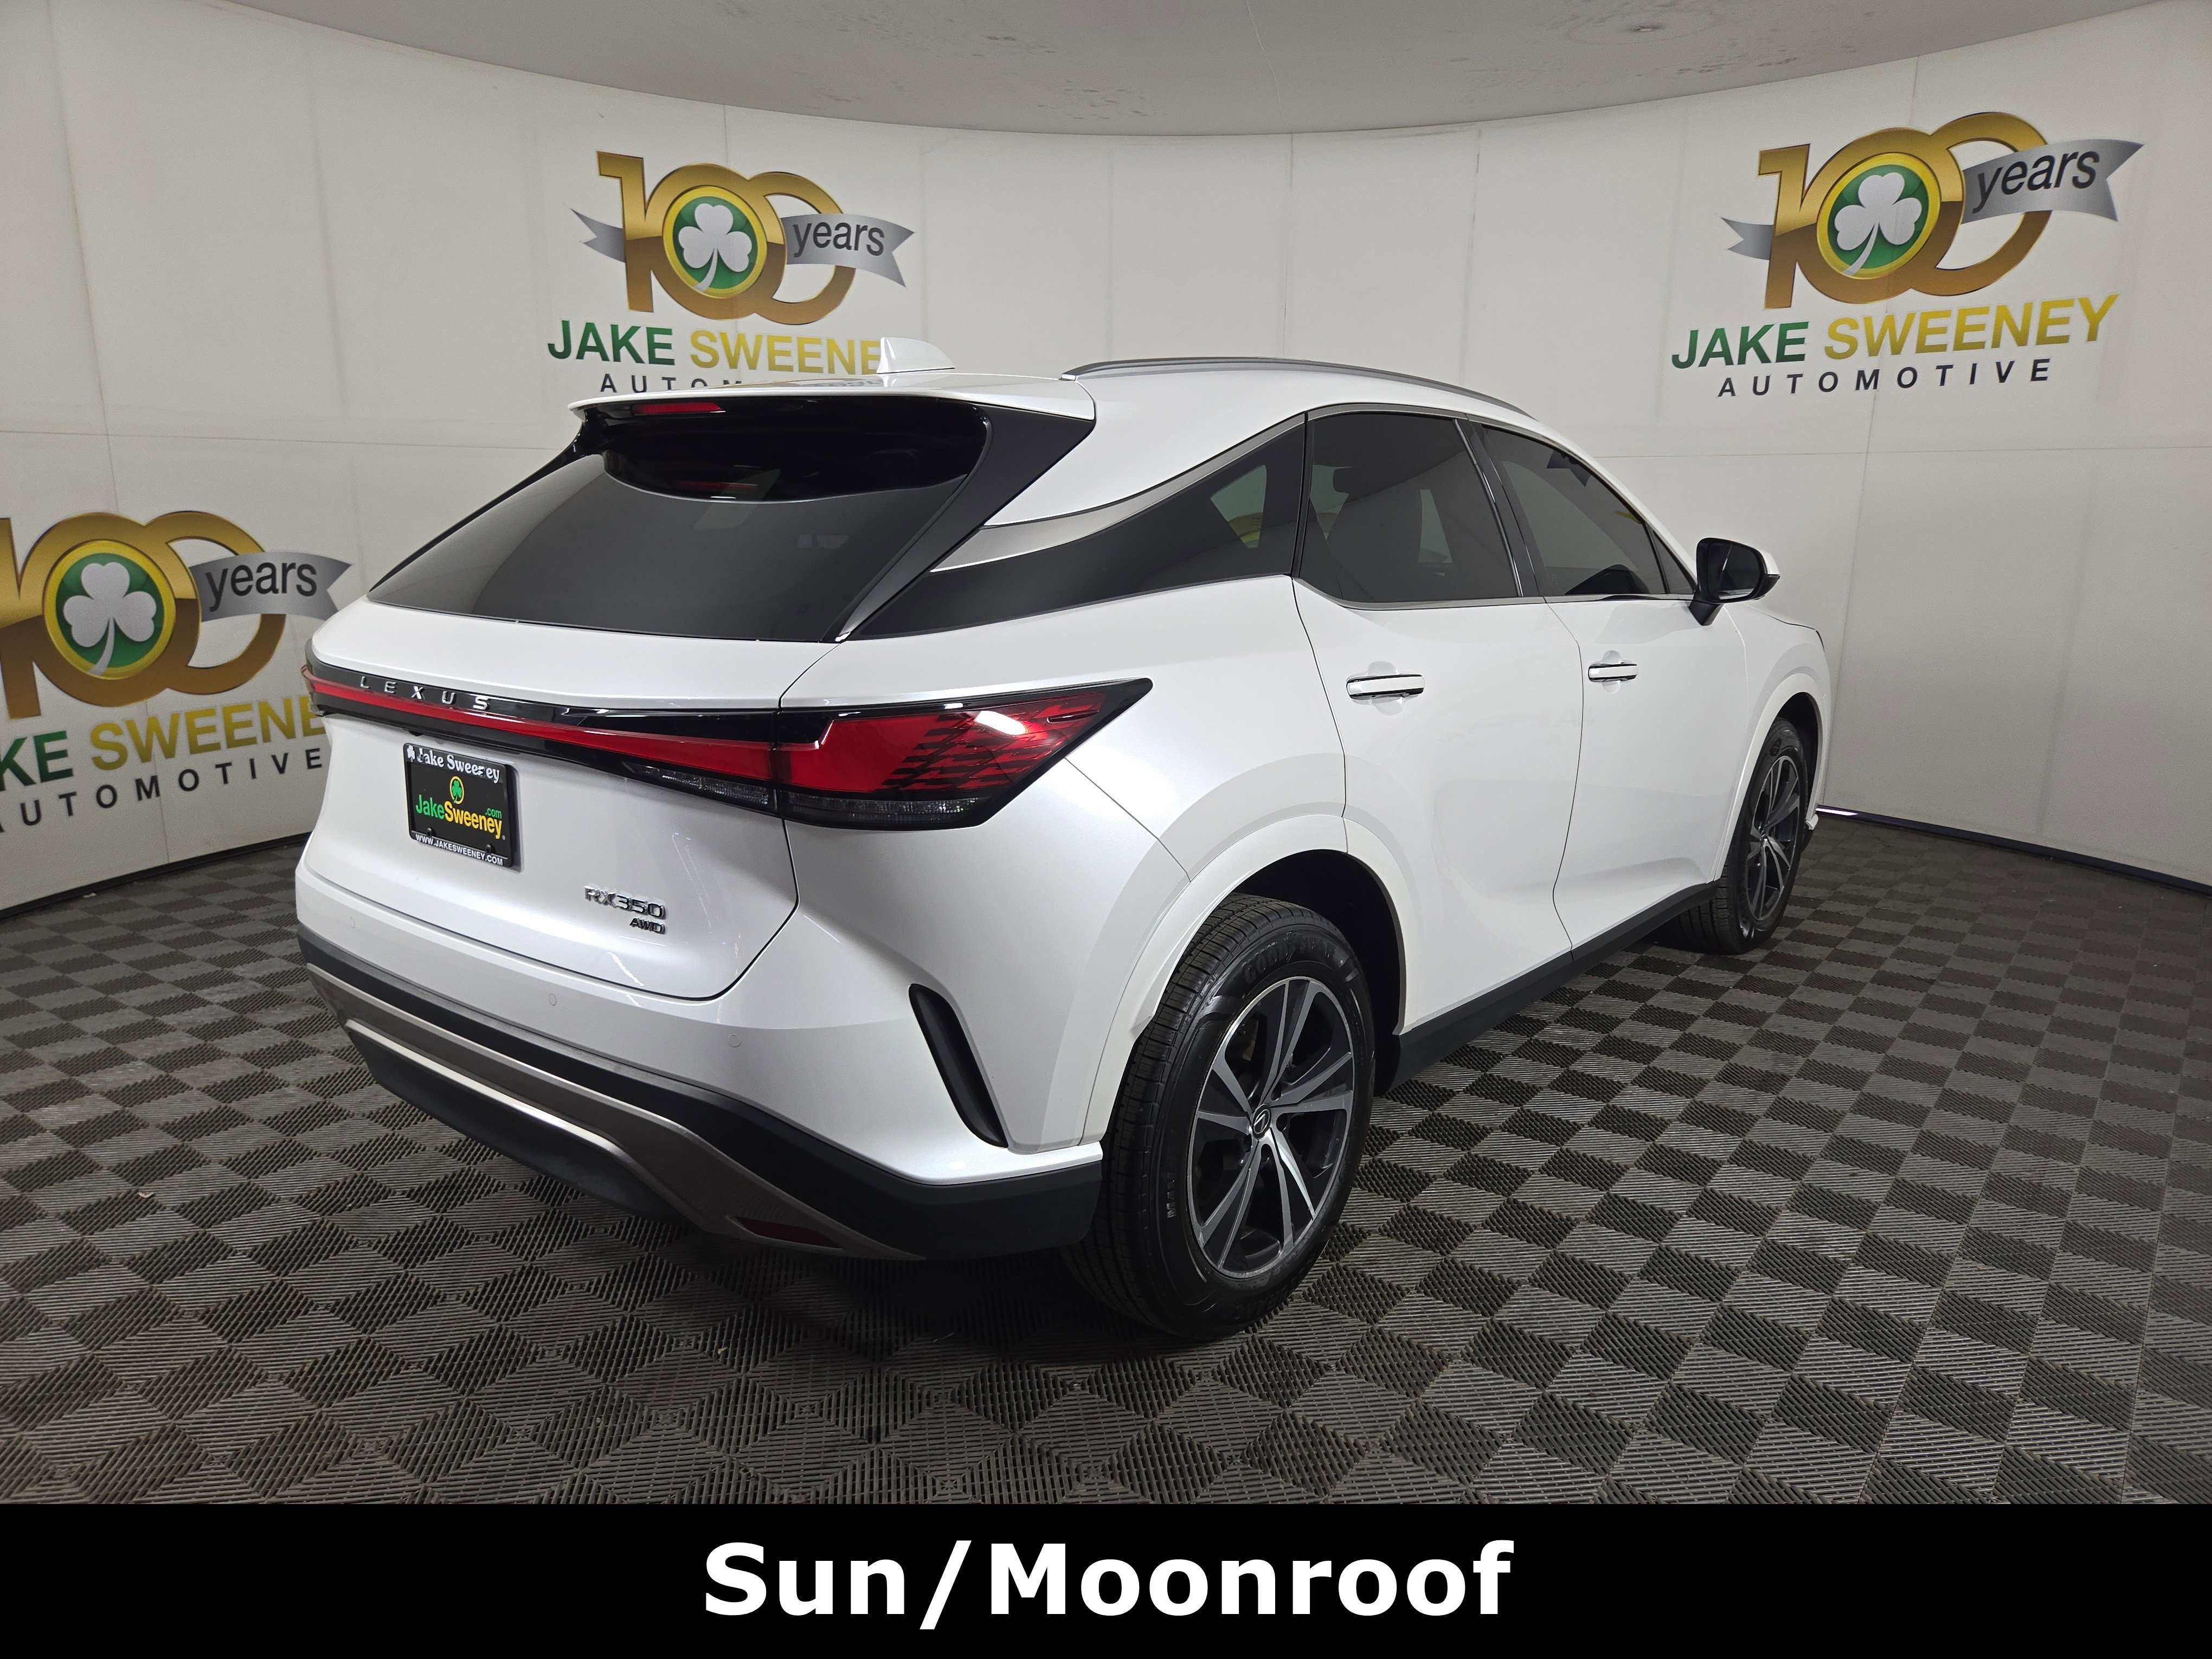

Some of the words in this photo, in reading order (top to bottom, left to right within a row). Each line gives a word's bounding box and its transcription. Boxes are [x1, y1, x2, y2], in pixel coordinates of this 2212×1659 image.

[1758, 112, 2053, 310] 100
[1973, 151, 2099, 214] years
[596, 151, 857, 325] 100
[793, 222, 885, 258] years
[548, 320, 675, 366] JAKE
[690, 330, 882, 375] SWEENE
[1671, 321, 1809, 369] JAKE
[1824, 294, 2119, 359] SWEENEY
[1718, 358, 2050, 398] AUTOMOTIVE
[206, 562, 317, 610] years
[360, 676, 491, 710] LEXUS
[0, 731, 74, 792] KE
[89, 696, 327, 770] SWEENE
[417, 748, 444, 767] Jake
[447, 754, 499, 783] Sweeey
[0, 748, 323, 833] UTOMOTIVE
[416, 794, 502, 839] JakeSweeney
[416, 834, 503, 866] WWW.JAKESWEENEY.COM
[584, 885, 668, 919] RX350
[629, 917, 666, 935] AWD
